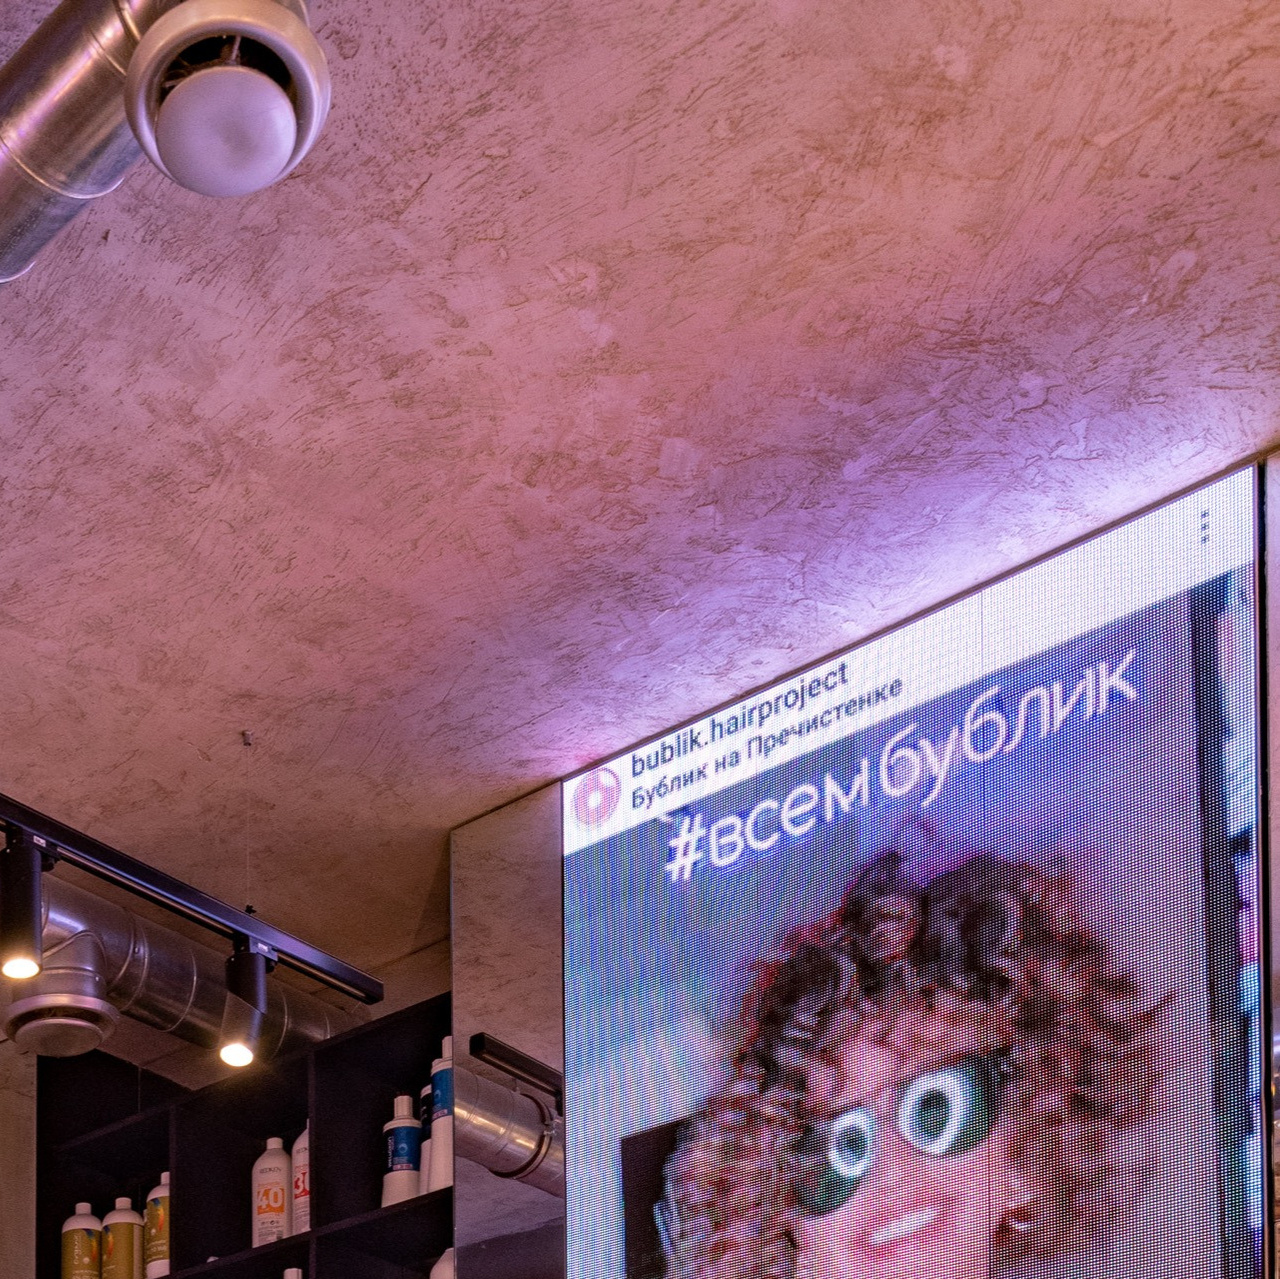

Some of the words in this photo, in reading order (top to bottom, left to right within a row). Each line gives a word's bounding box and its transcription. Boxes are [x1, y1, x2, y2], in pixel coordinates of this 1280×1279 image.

[631, 661, 849, 779] bublik.hairproject
[631, 760, 708, 811] Бублик
[714, 750, 740, 774] на
[747, 676, 903, 759] Пречистенке
[258, 1187, 283, 1209] 40
